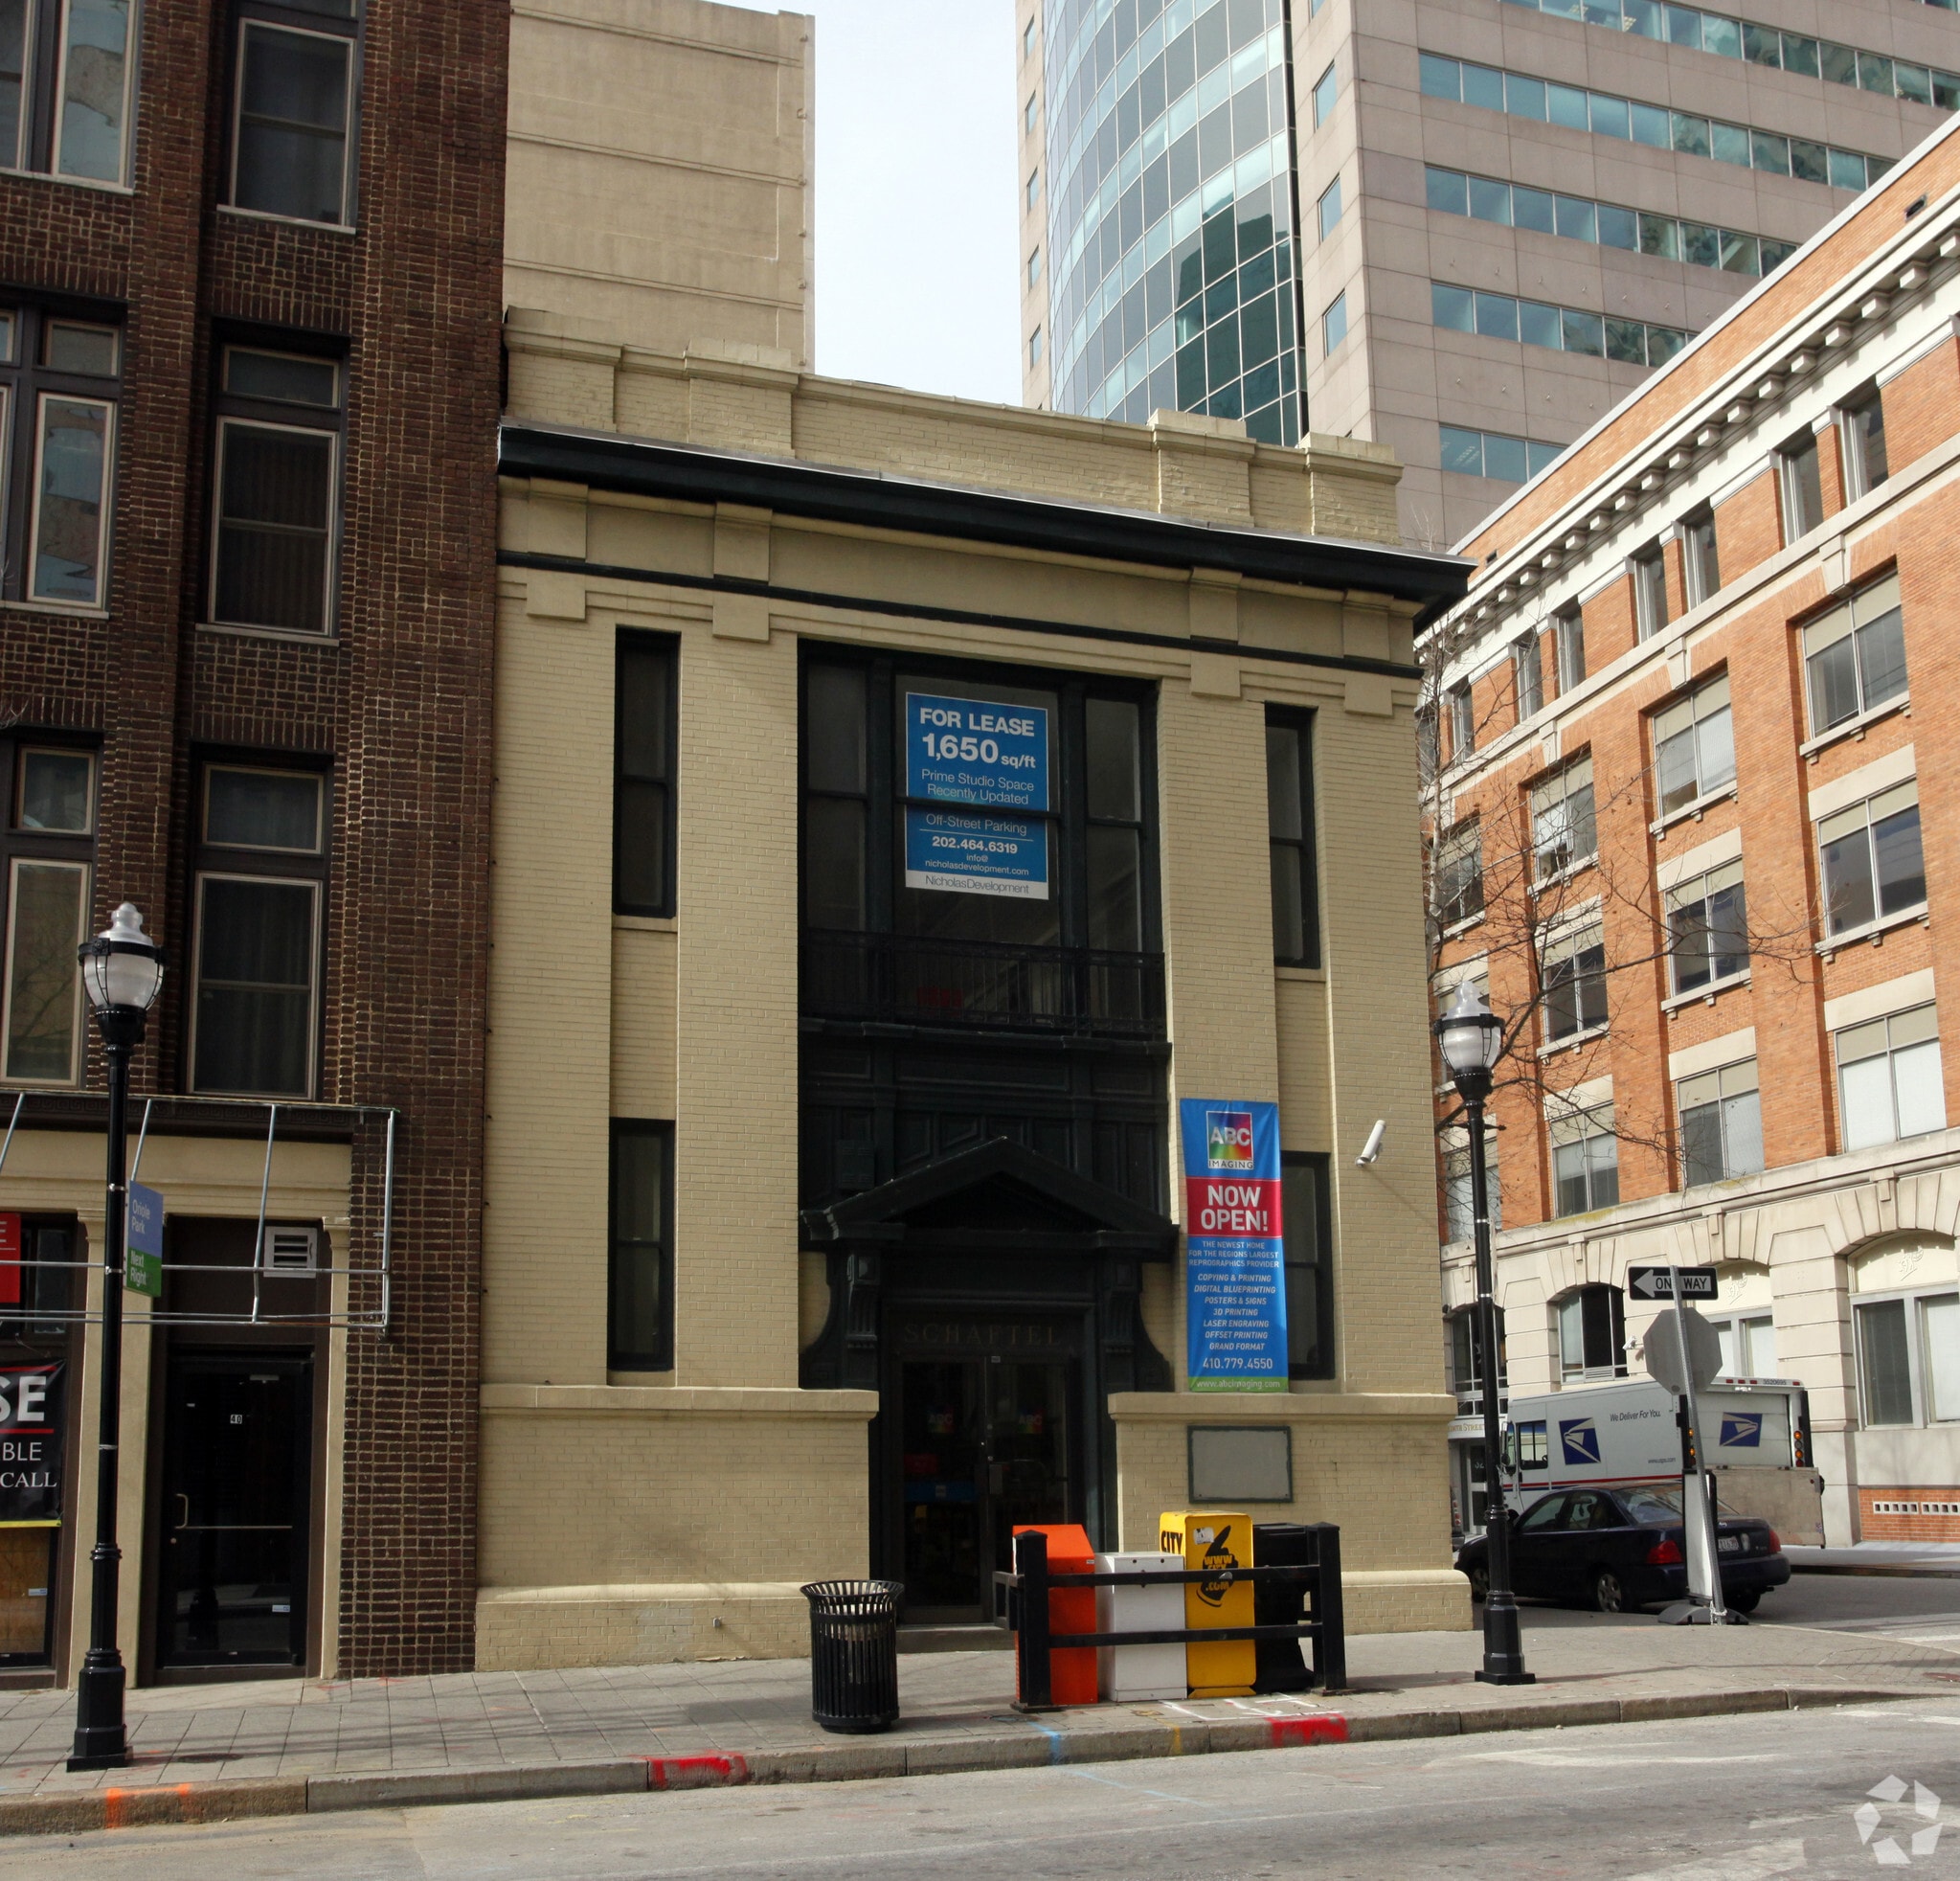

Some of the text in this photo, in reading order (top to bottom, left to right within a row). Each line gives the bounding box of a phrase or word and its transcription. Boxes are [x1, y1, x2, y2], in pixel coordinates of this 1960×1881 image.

[920, 708, 1034, 737] FOR LEASE
[923, 733, 1035, 769] 1,650 sq/ft
[922, 769, 1034, 791] Prime Studio Space
[928, 784, 1028, 805] Recently Updated
[926, 814, 1026, 836] Off-Street Parking
[933, 836, 1018, 853] 202.464.6319
[966, 853, 988, 862] info@
[925, 860, 1028, 875] nicholasdevelopment.com
[926, 874, 1028, 894] NicholasDevelopment
[1210, 1126, 1250, 1146] ABC
[1209, 1160, 1253, 1168] IMAGING
[1207, 1185, 1261, 1207] NOW
[133, 1199, 150, 1219] Oriole
[132, 1216, 145, 1234] Park
[1201, 1209, 1268, 1231] OPEN!
[131, 1251, 144, 1267] Next
[130, 1268, 146, 1287] Right
[1656, 1277, 1706, 1289] ON WAY
[1203, 1358, 1273, 1369] 410.779.4550
[1197, 1379, 1280, 1389] www.abcimaging.com
[1620, 1412, 1638, 1420] Deliver
[3, 1442, 42, 1461] BLE
[0, 1472, 57, 1487] CALL
[1161, 1530, 1183, 1554] CITY
